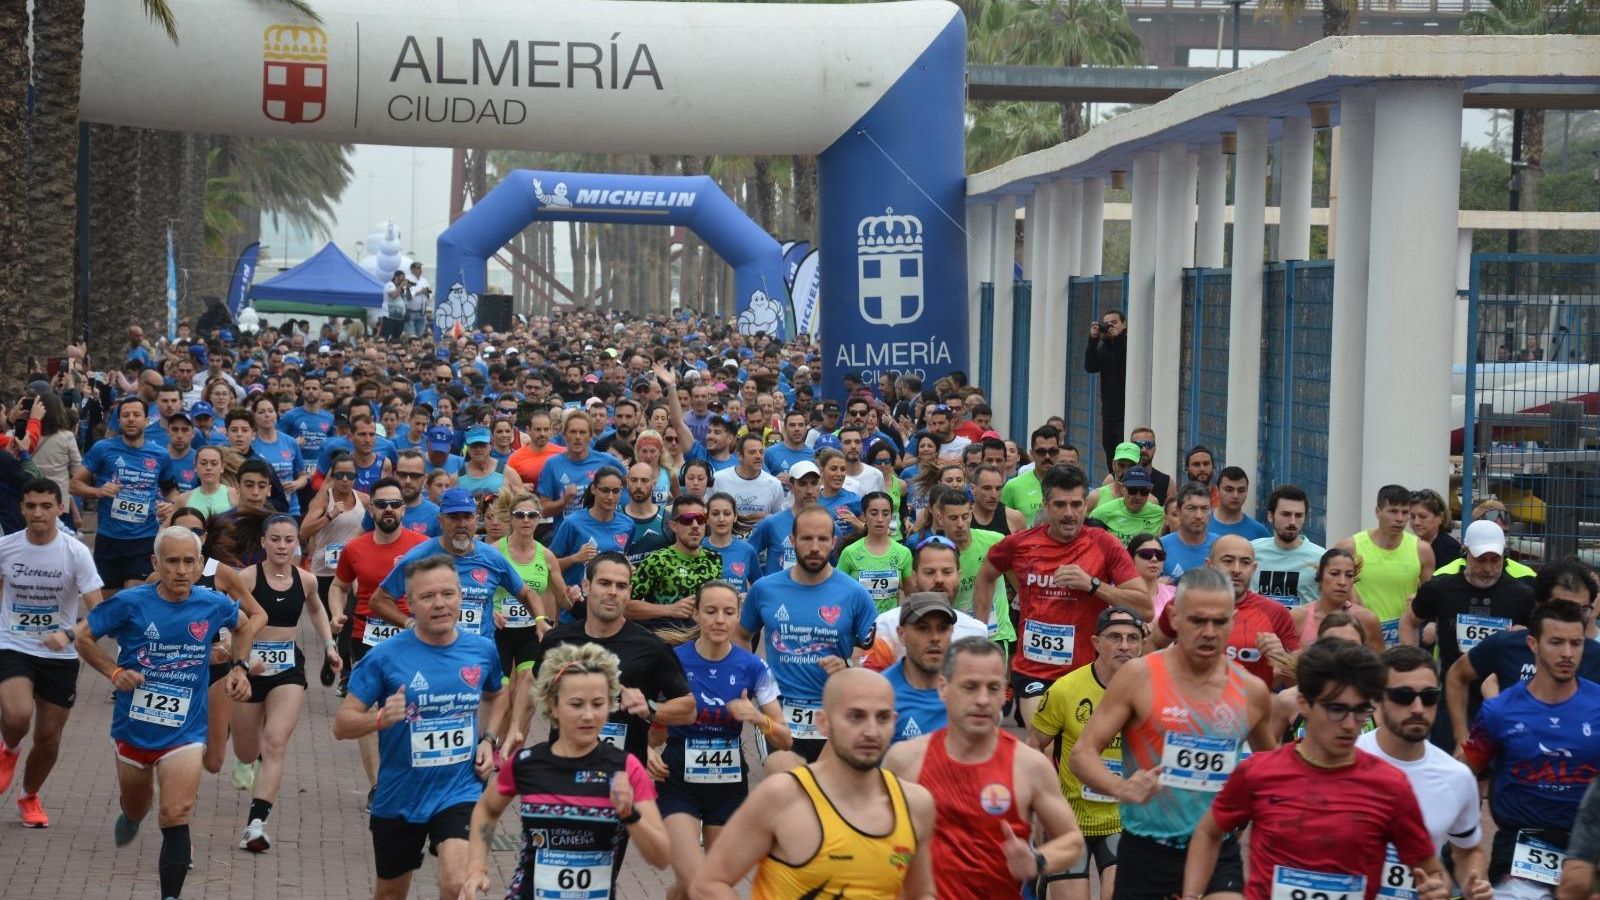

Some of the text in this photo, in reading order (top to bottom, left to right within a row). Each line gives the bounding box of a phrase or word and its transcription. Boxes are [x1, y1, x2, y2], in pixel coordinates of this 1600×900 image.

[389, 32, 664, 90] ALMERÍA
[387, 94, 527, 125] CIUDAD
[576, 189, 697, 207] MICHELIN
[835, 335, 952, 367] ALMERÍA
[120, 500, 144, 513] 662
[12, 563, 62, 578] Florencio
[871, 578, 889, 589] 79
[1259, 585, 1294, 595] UAL
[19, 614, 52, 626] 249
[372, 626, 400, 639] 440
[1031, 633, 1065, 651] 563
[258, 650, 287, 663] 330
[144, 692, 180, 712] 123
[424, 730, 464, 750] 116
[695, 750, 733, 767] 444
[1177, 749, 1224, 772] 696
[1527, 849, 1559, 870] 53
[558, 868, 592, 890] 60
